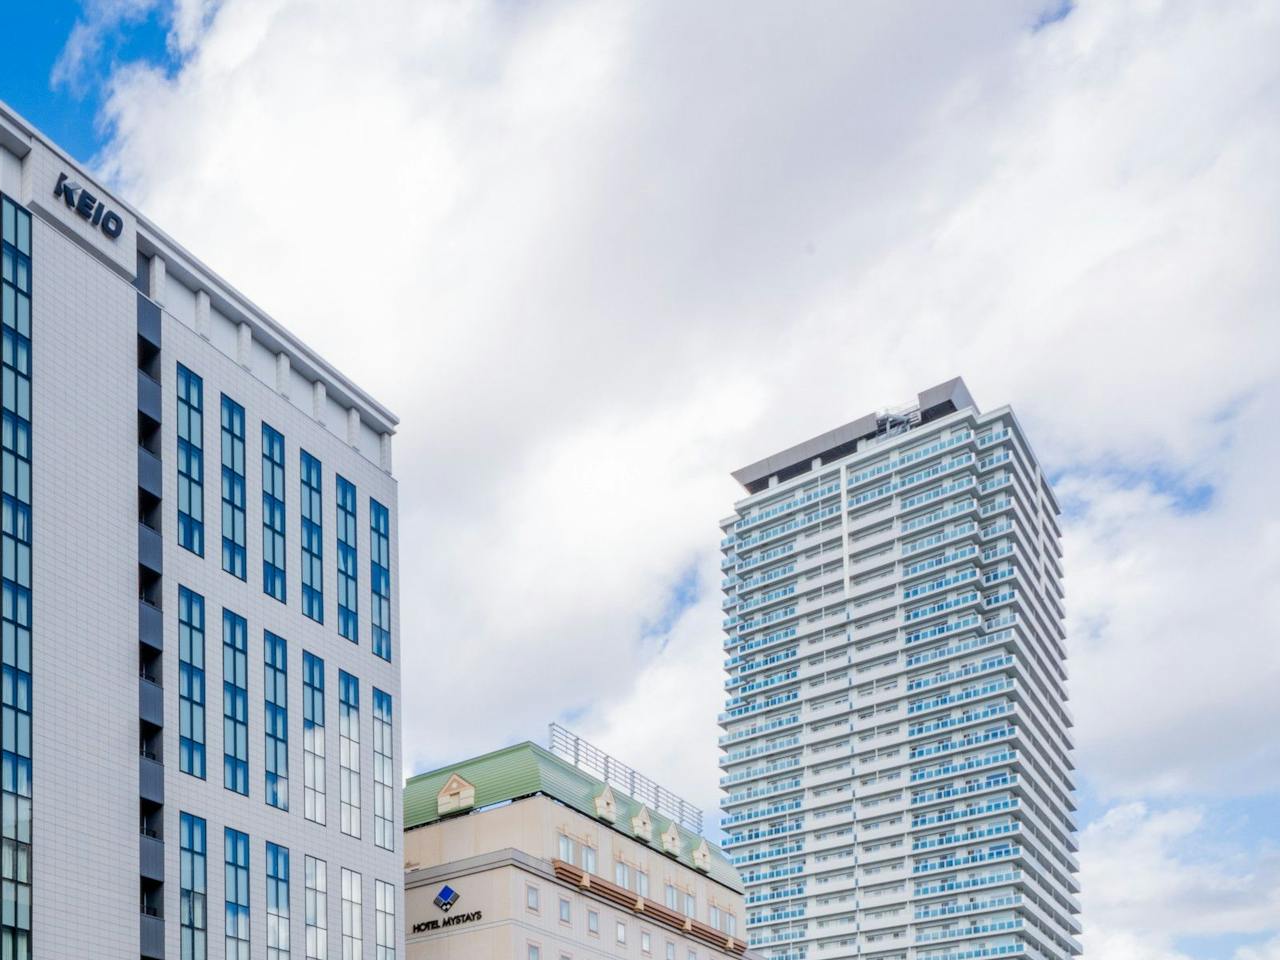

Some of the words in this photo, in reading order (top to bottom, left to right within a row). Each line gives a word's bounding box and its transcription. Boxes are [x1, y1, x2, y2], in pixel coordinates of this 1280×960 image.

[54, 172, 124, 239] KEIO
[413, 920, 440, 934] HOTEL
[442, 910, 482, 928] MYSTAYS
